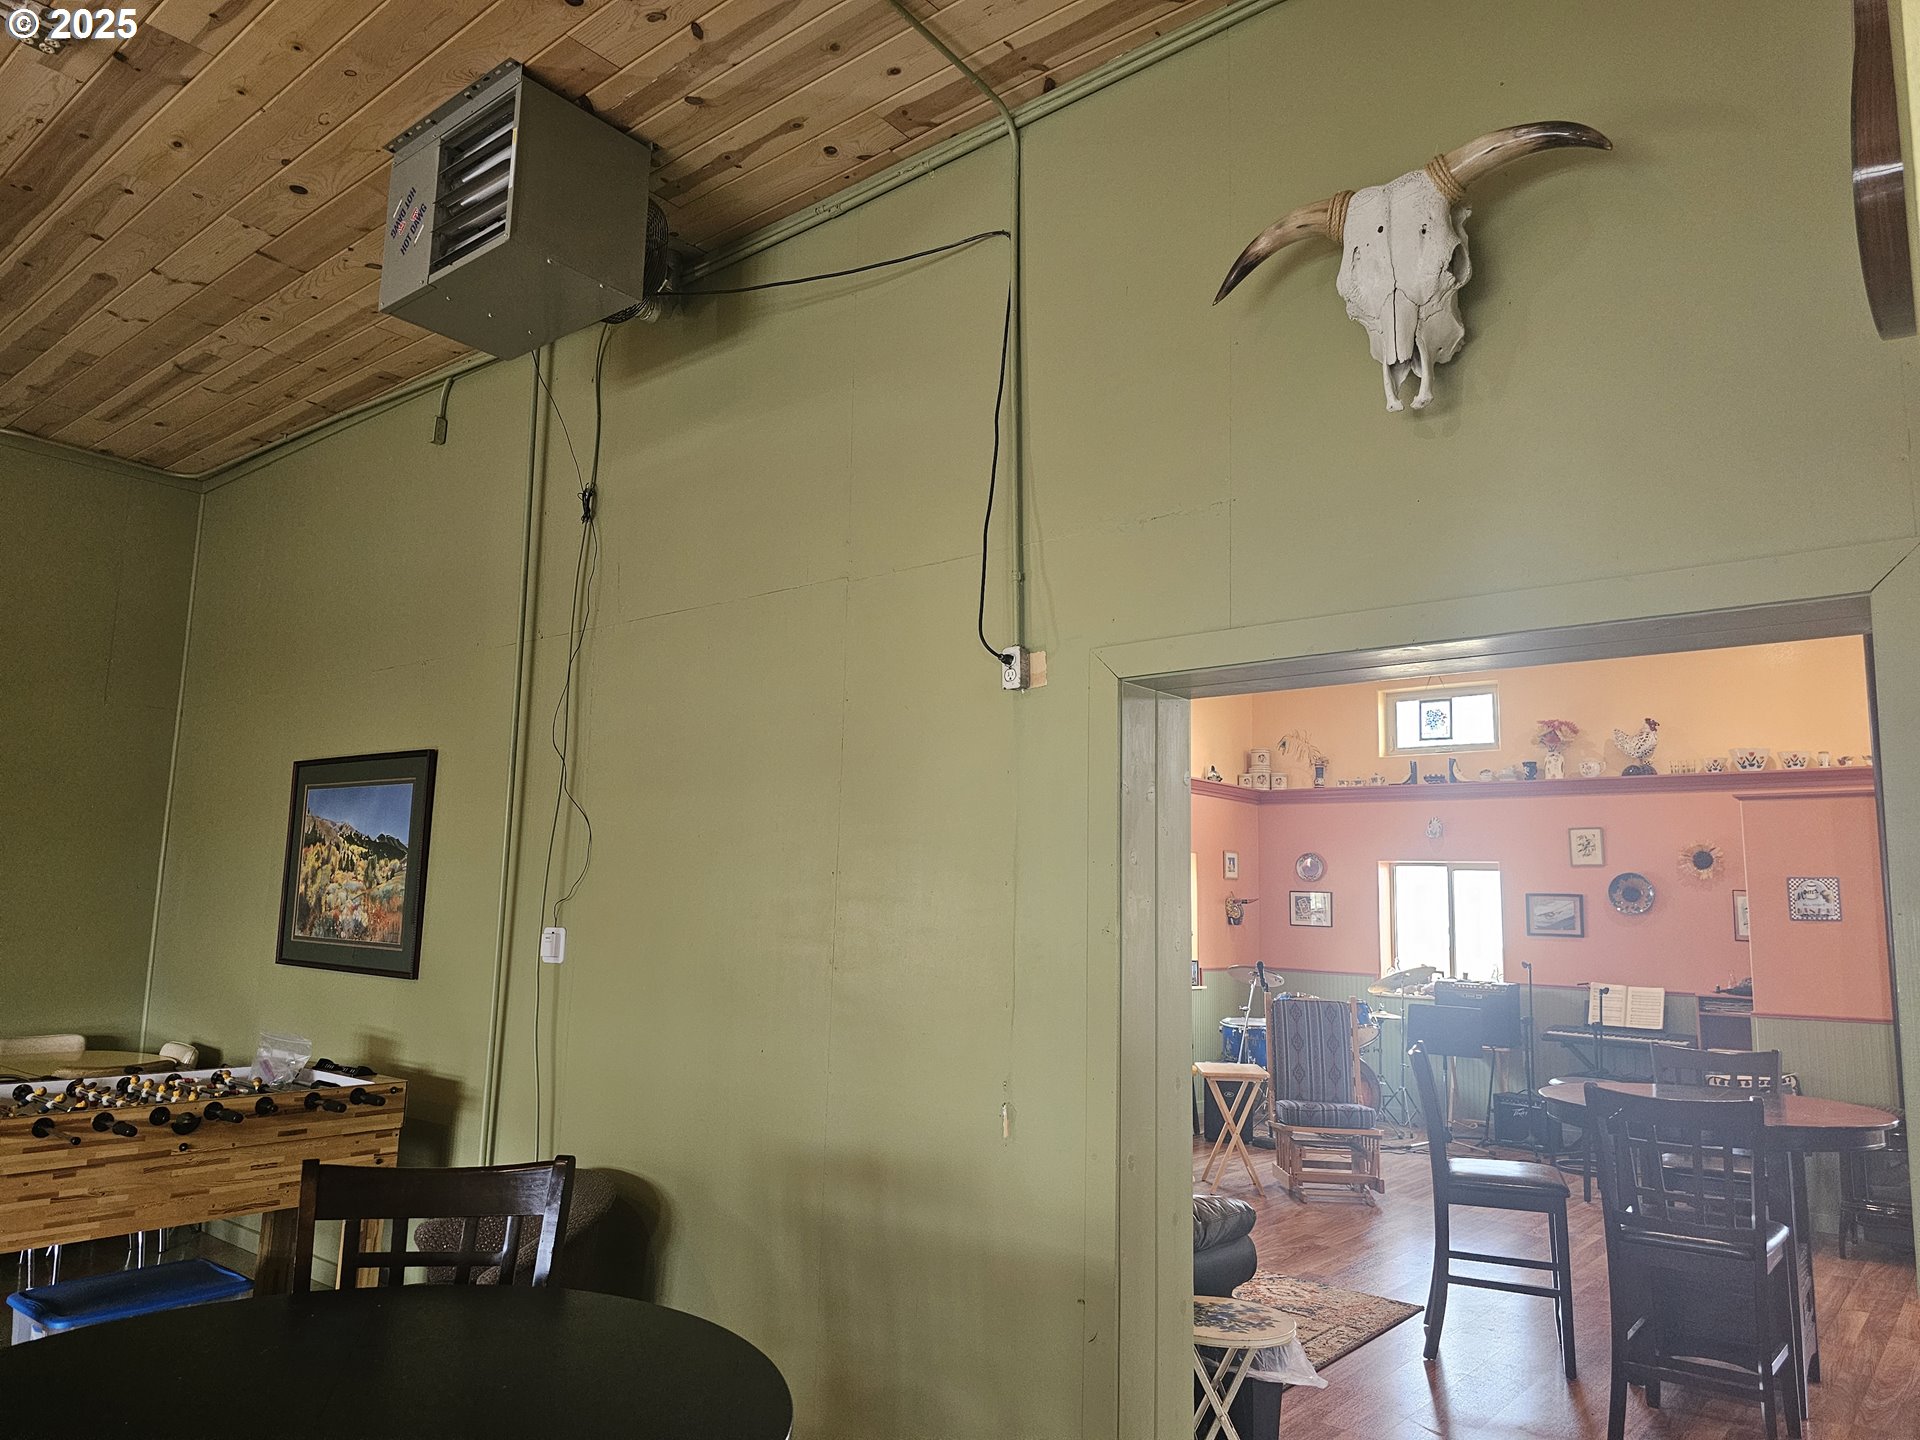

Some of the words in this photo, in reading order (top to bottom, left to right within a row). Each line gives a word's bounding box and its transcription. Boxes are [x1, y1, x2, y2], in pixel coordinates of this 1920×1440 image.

[405, 187, 417, 210] HOT
[391, 208, 406, 239] DAWG
[400, 233, 412, 256] HOT
[410, 203, 427, 234] DAWG
